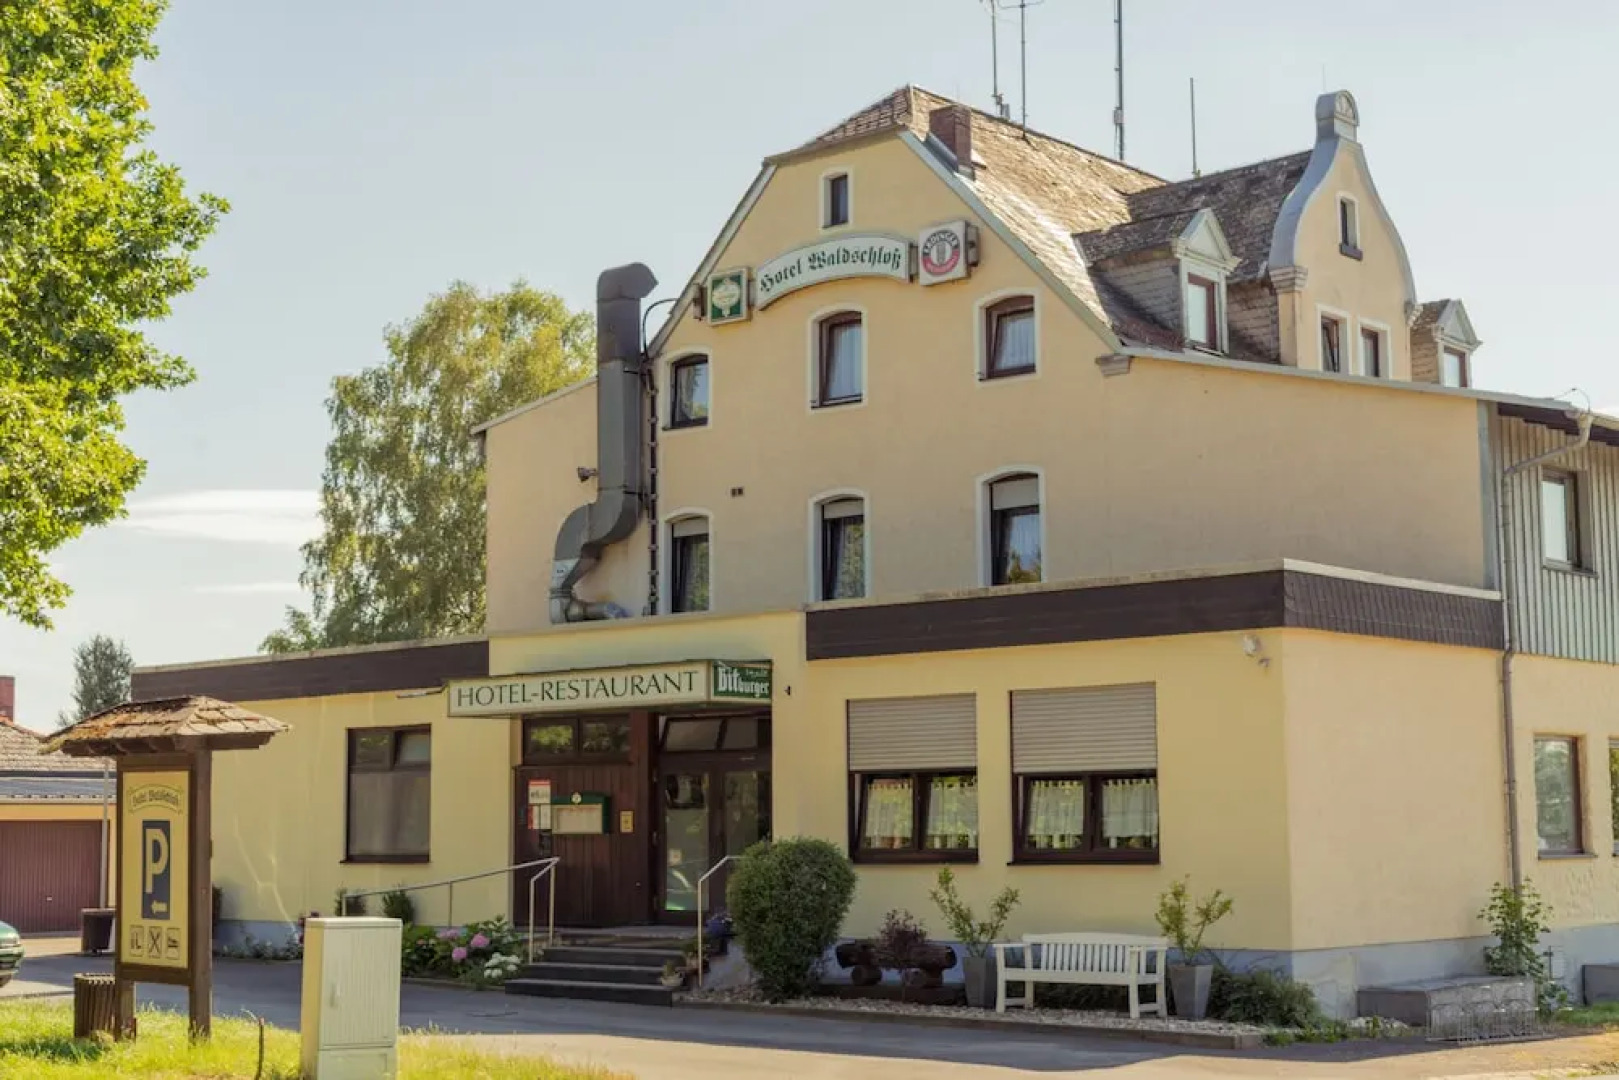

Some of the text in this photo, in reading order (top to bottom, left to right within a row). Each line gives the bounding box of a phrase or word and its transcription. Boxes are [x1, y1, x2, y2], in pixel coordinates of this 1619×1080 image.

[760, 258, 802, 292] Hotel
[807, 246, 901, 270] Waldschloß
[457, 671, 698, 707] HOTEL-RESTAURANT
[145, 828, 169, 894] P
